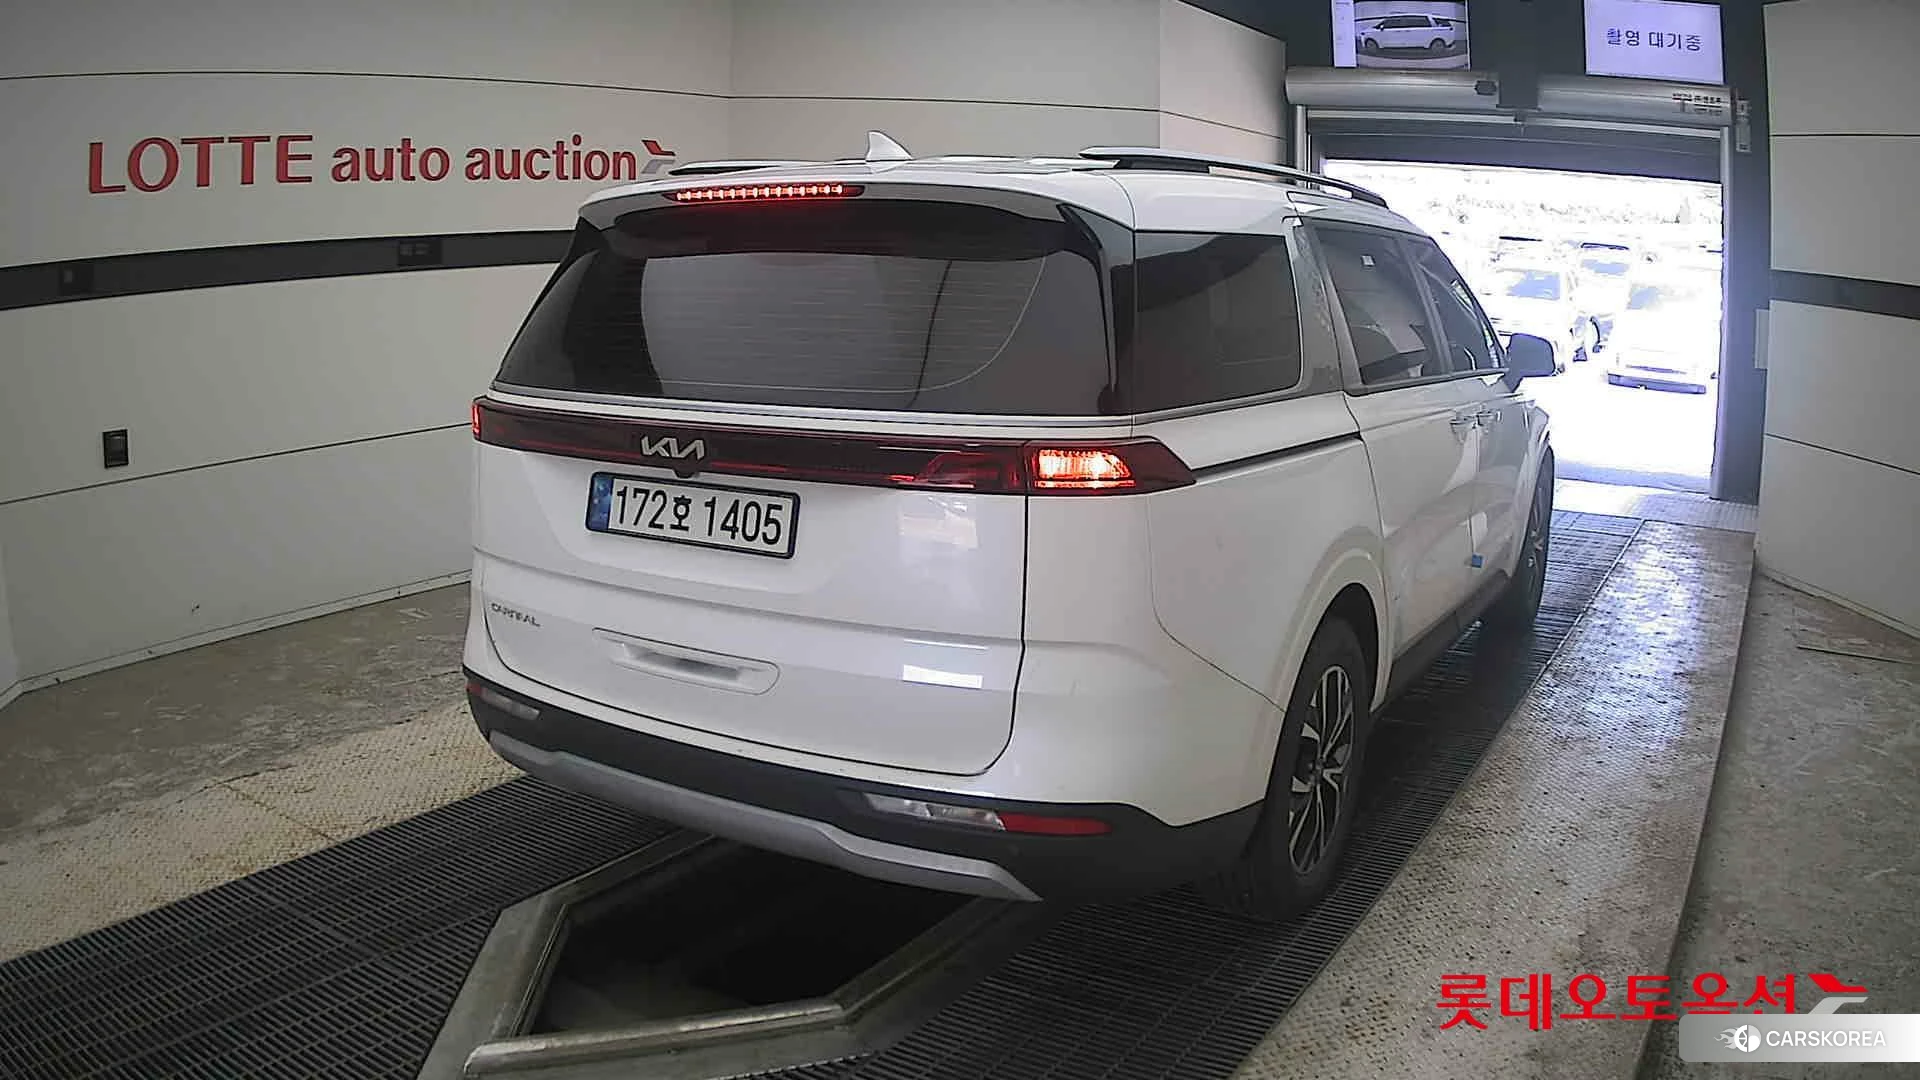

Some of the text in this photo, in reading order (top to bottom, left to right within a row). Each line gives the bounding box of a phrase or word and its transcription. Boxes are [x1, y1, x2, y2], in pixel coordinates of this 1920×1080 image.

[1607, 28, 1701, 51] 촬영 대기중
[89, 134, 637, 194] LOTTE auto auction
[641, 435, 705, 460] KIA
[614, 485, 783, 546] 172호 1405
